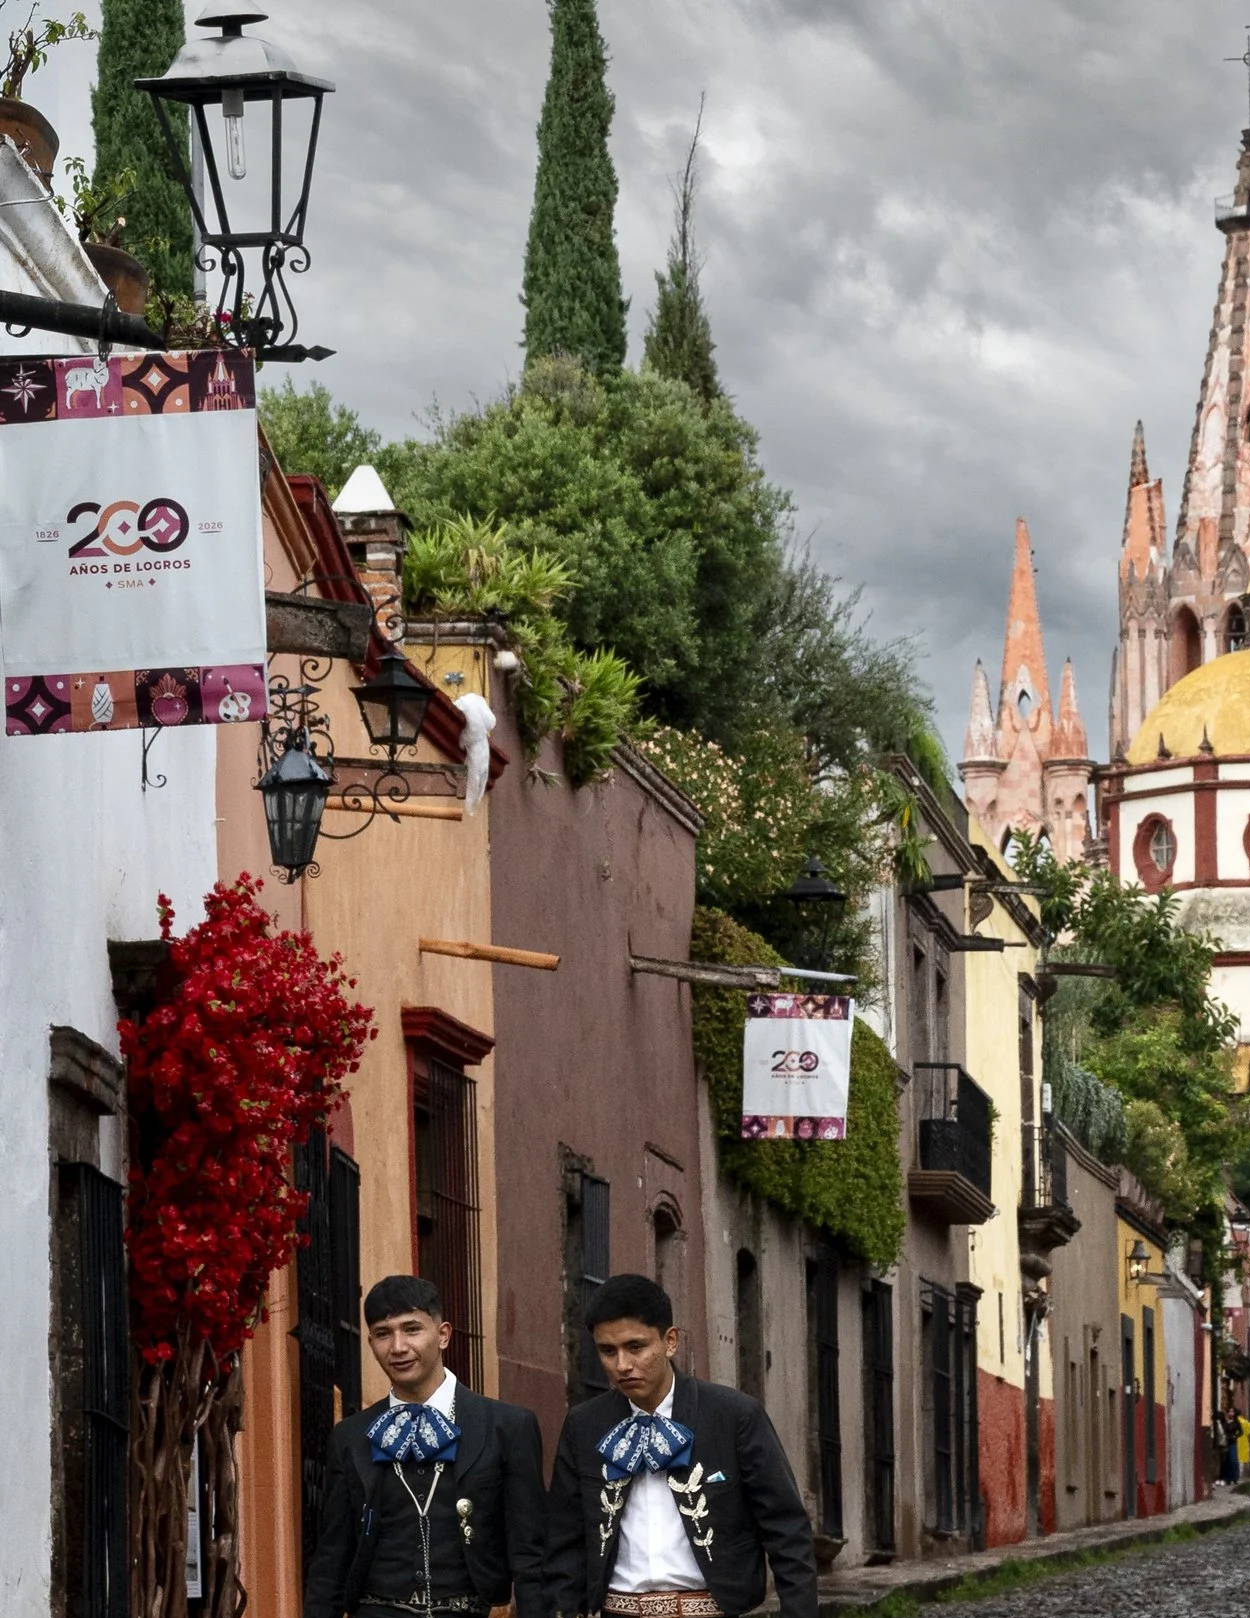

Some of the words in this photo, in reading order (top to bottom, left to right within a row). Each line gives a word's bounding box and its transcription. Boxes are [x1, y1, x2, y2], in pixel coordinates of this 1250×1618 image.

[66, 497, 190, 558] 200
[198, 521, 223, 531] 2026
[35, 530, 60, 539] 1826
[69, 562, 108, 576] AÑOS
[113, 563, 131, 573] DE
[136, 559, 191, 572] LOGROS
[117, 579, 144, 589] SMA
